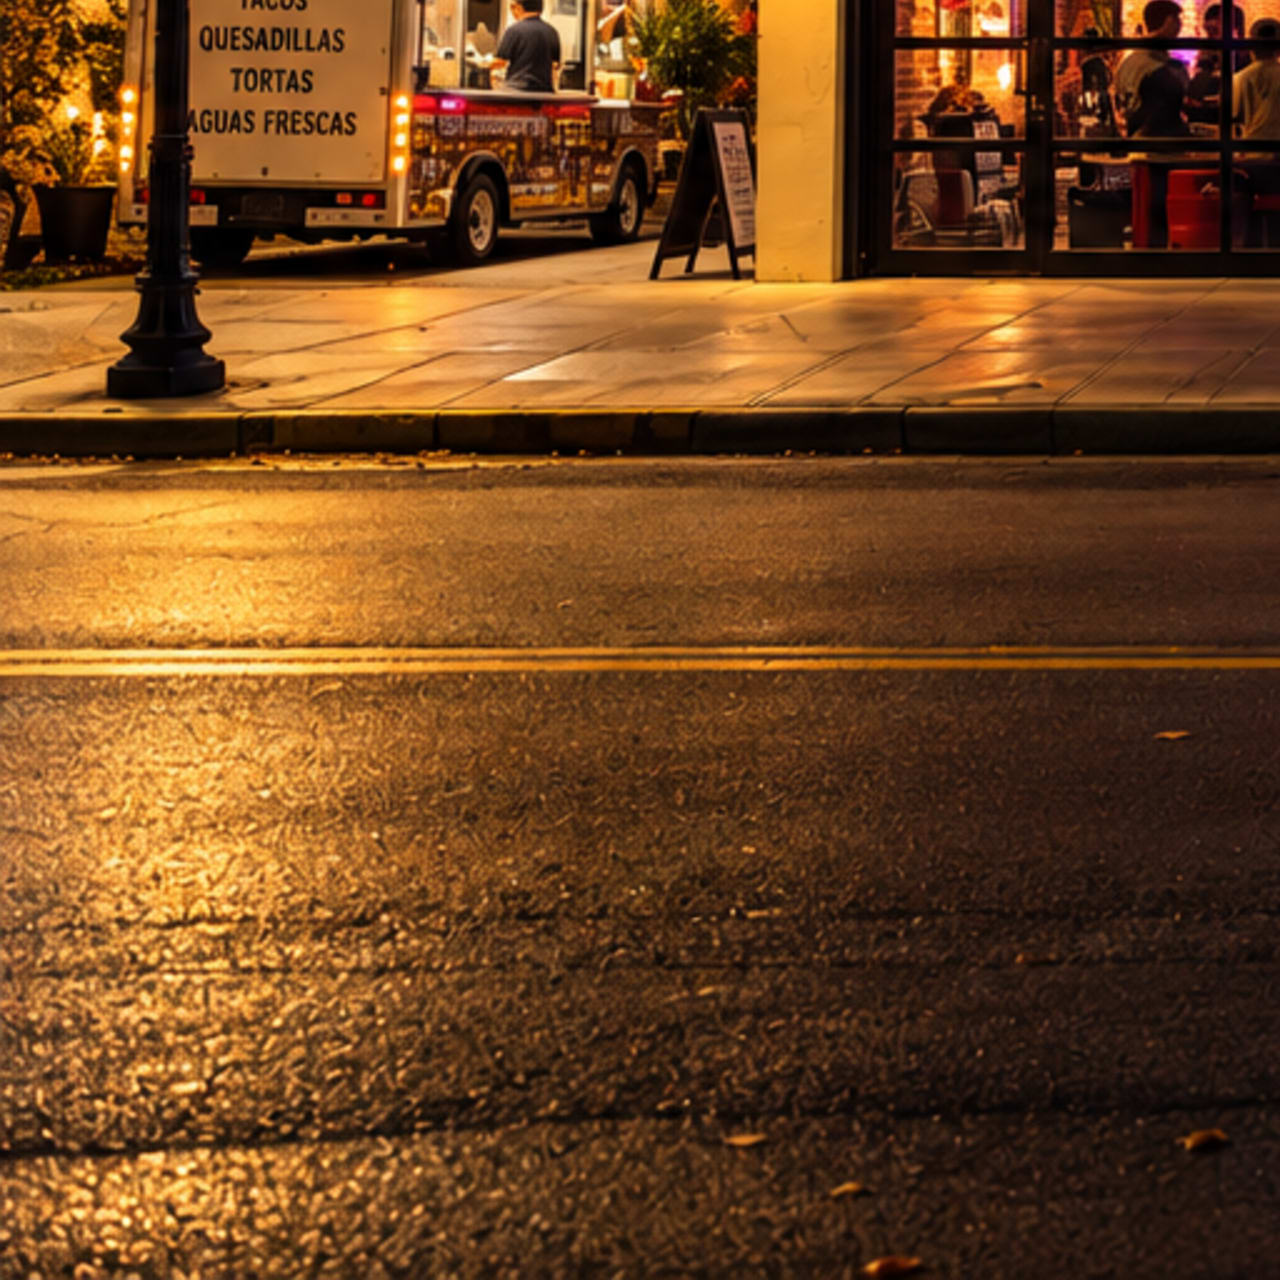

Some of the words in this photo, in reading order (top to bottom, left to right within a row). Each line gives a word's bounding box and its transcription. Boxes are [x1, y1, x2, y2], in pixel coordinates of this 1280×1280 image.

[199, 25, 345, 53] QUESADILLAS
[230, 68, 314, 94] TORTAS
[264, 111, 357, 136] FRESCAS
